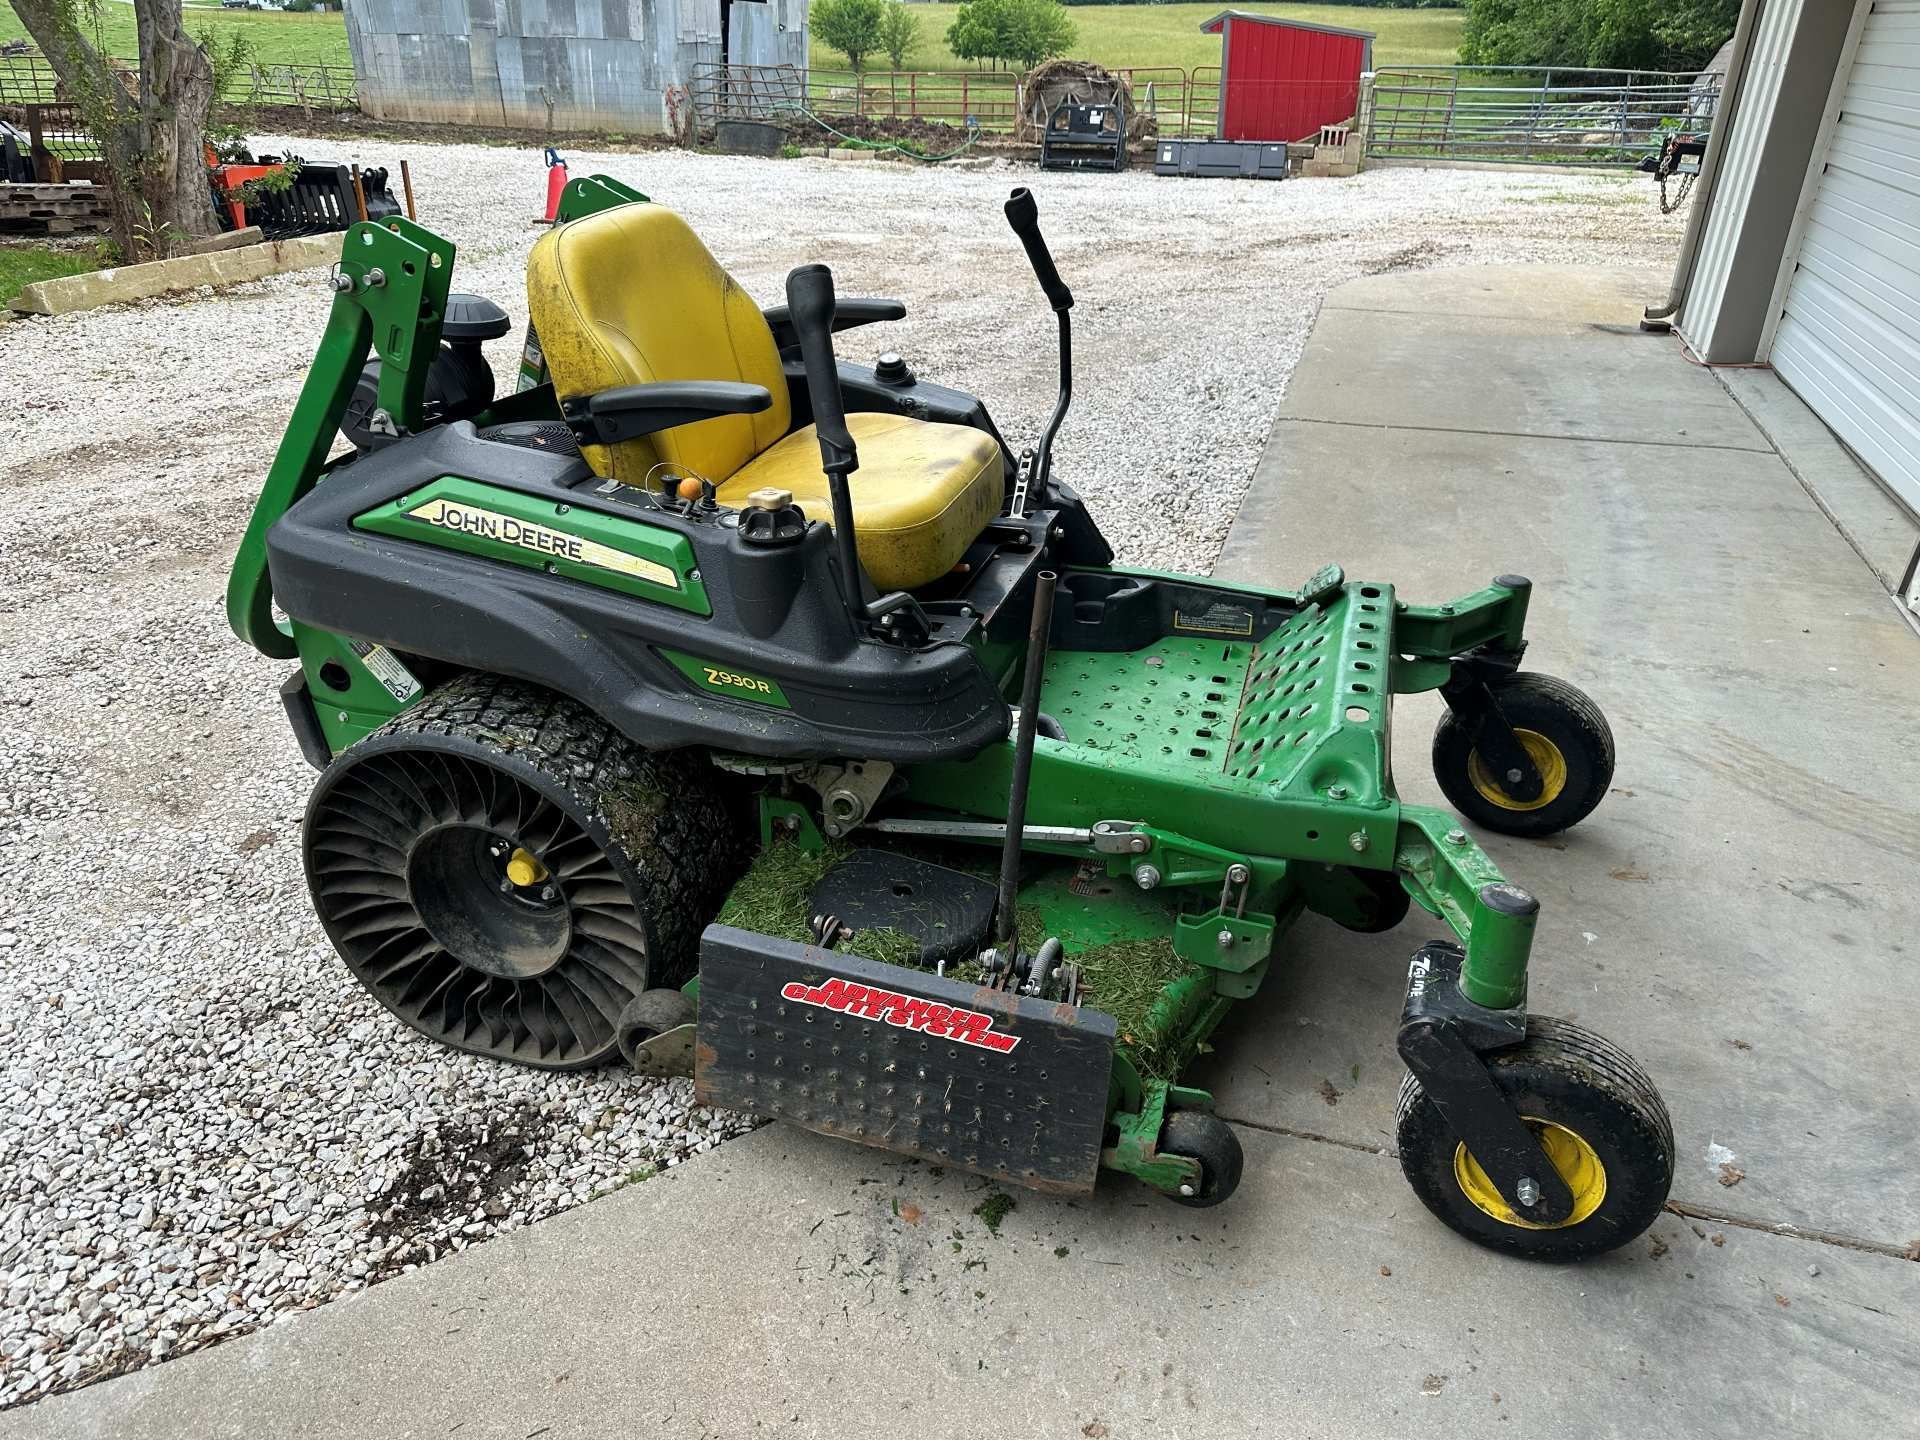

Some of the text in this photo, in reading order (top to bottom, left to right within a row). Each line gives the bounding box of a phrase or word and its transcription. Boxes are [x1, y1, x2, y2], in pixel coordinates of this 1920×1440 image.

[432, 503, 583, 561] JOHN DEERE
[703, 667, 772, 694] Z930R
[782, 983, 1019, 1052] CHUTE SYSTEM
[818, 978, 993, 1031] ADVANCED
